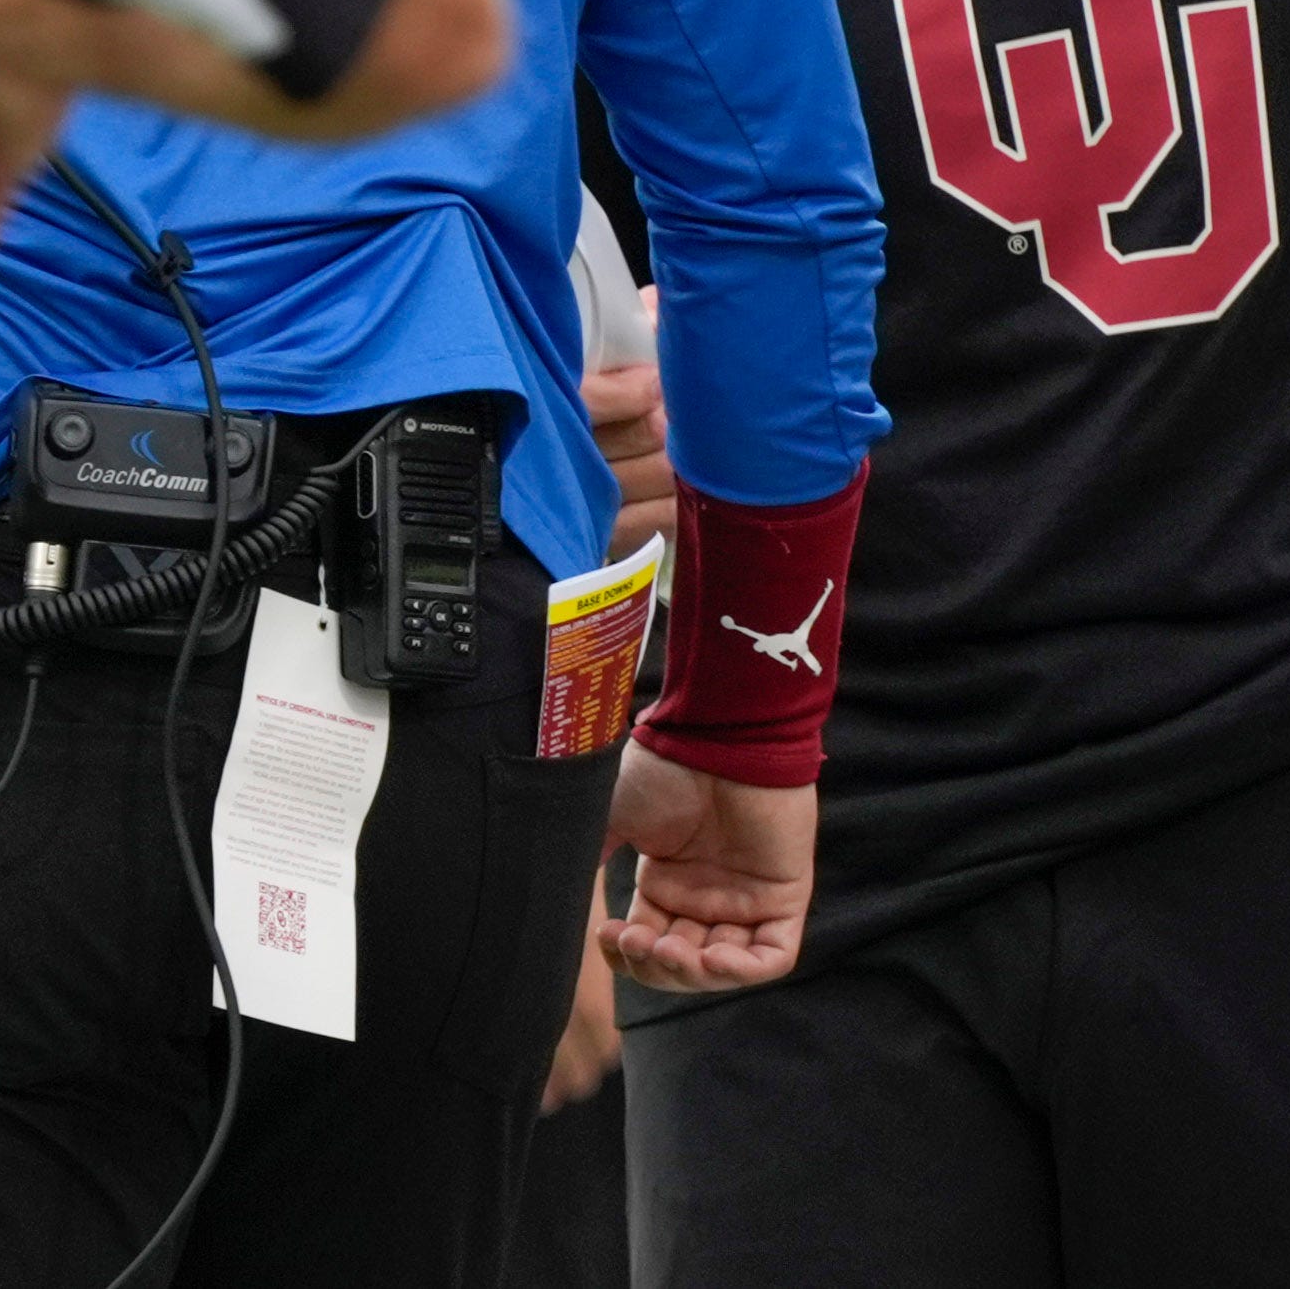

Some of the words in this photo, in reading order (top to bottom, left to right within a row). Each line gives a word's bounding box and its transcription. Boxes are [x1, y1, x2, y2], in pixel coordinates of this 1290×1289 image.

[420, 422, 475, 435] MOTOROLA
[77, 462, 209, 493] CoachComm
[577, 593, 602, 610] BASE
